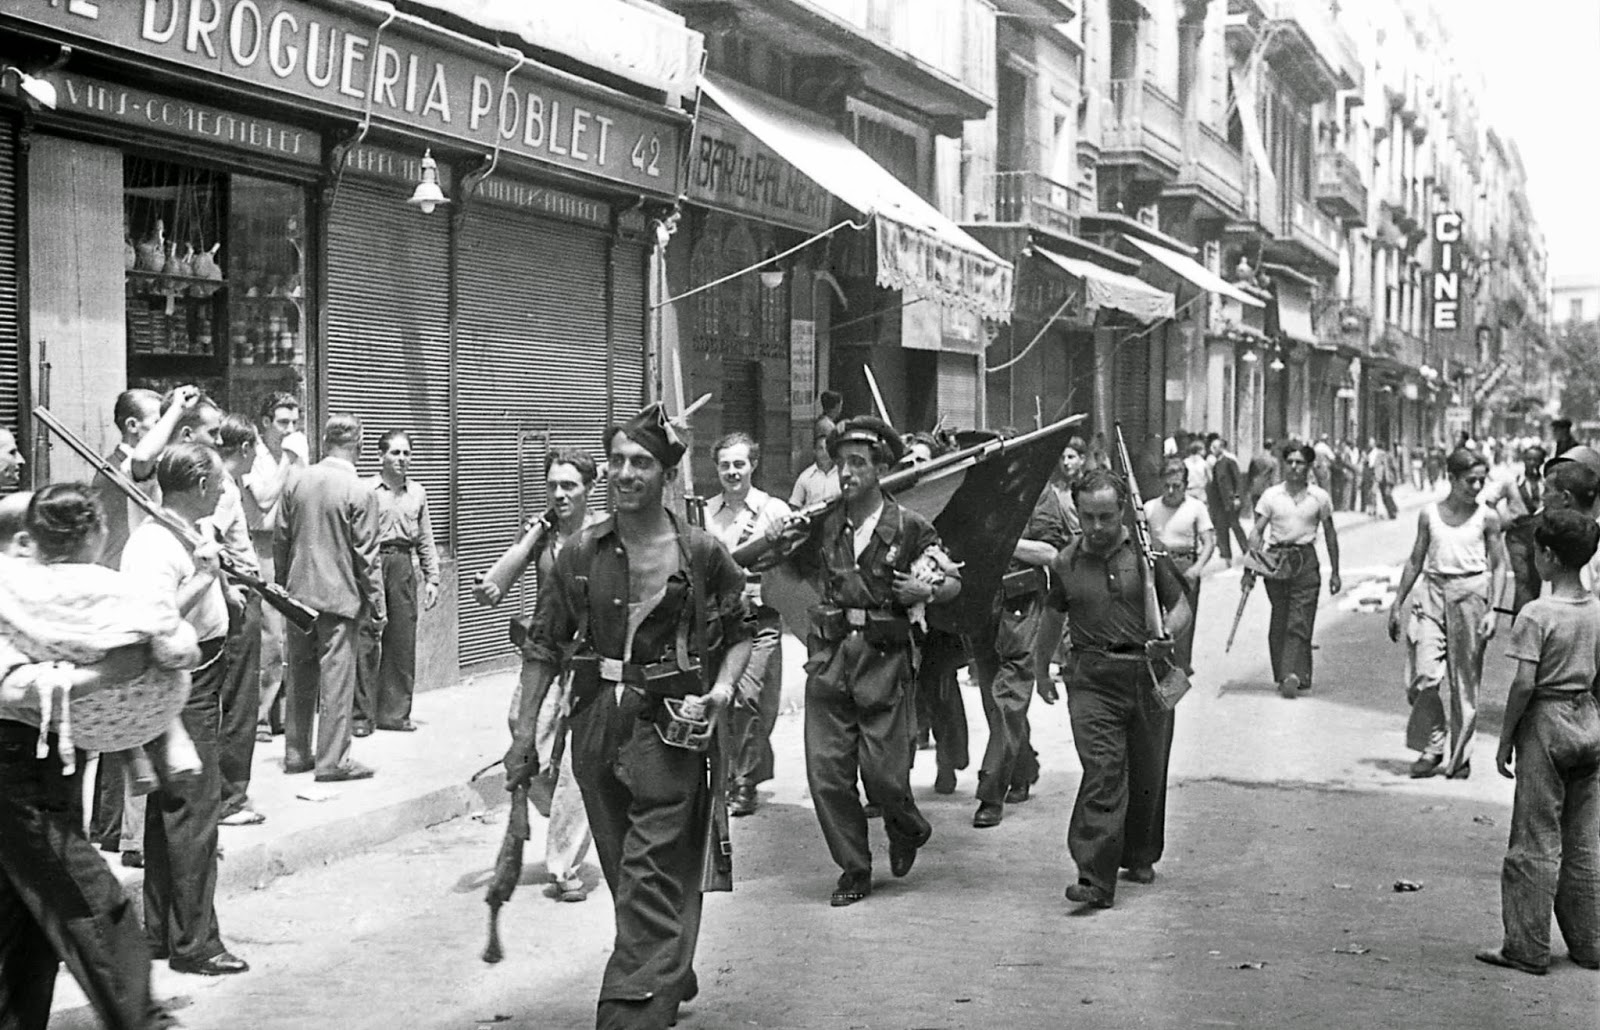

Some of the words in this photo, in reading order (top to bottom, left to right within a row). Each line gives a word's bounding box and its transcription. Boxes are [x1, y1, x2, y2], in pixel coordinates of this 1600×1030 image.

[141, 0, 451, 123] DROGUERIA
[469, 75, 613, 165] POBLET
[631, 133, 660, 176] 42
[698, 135, 736, 193] BAR
[1434, 213, 1461, 329] CINE
